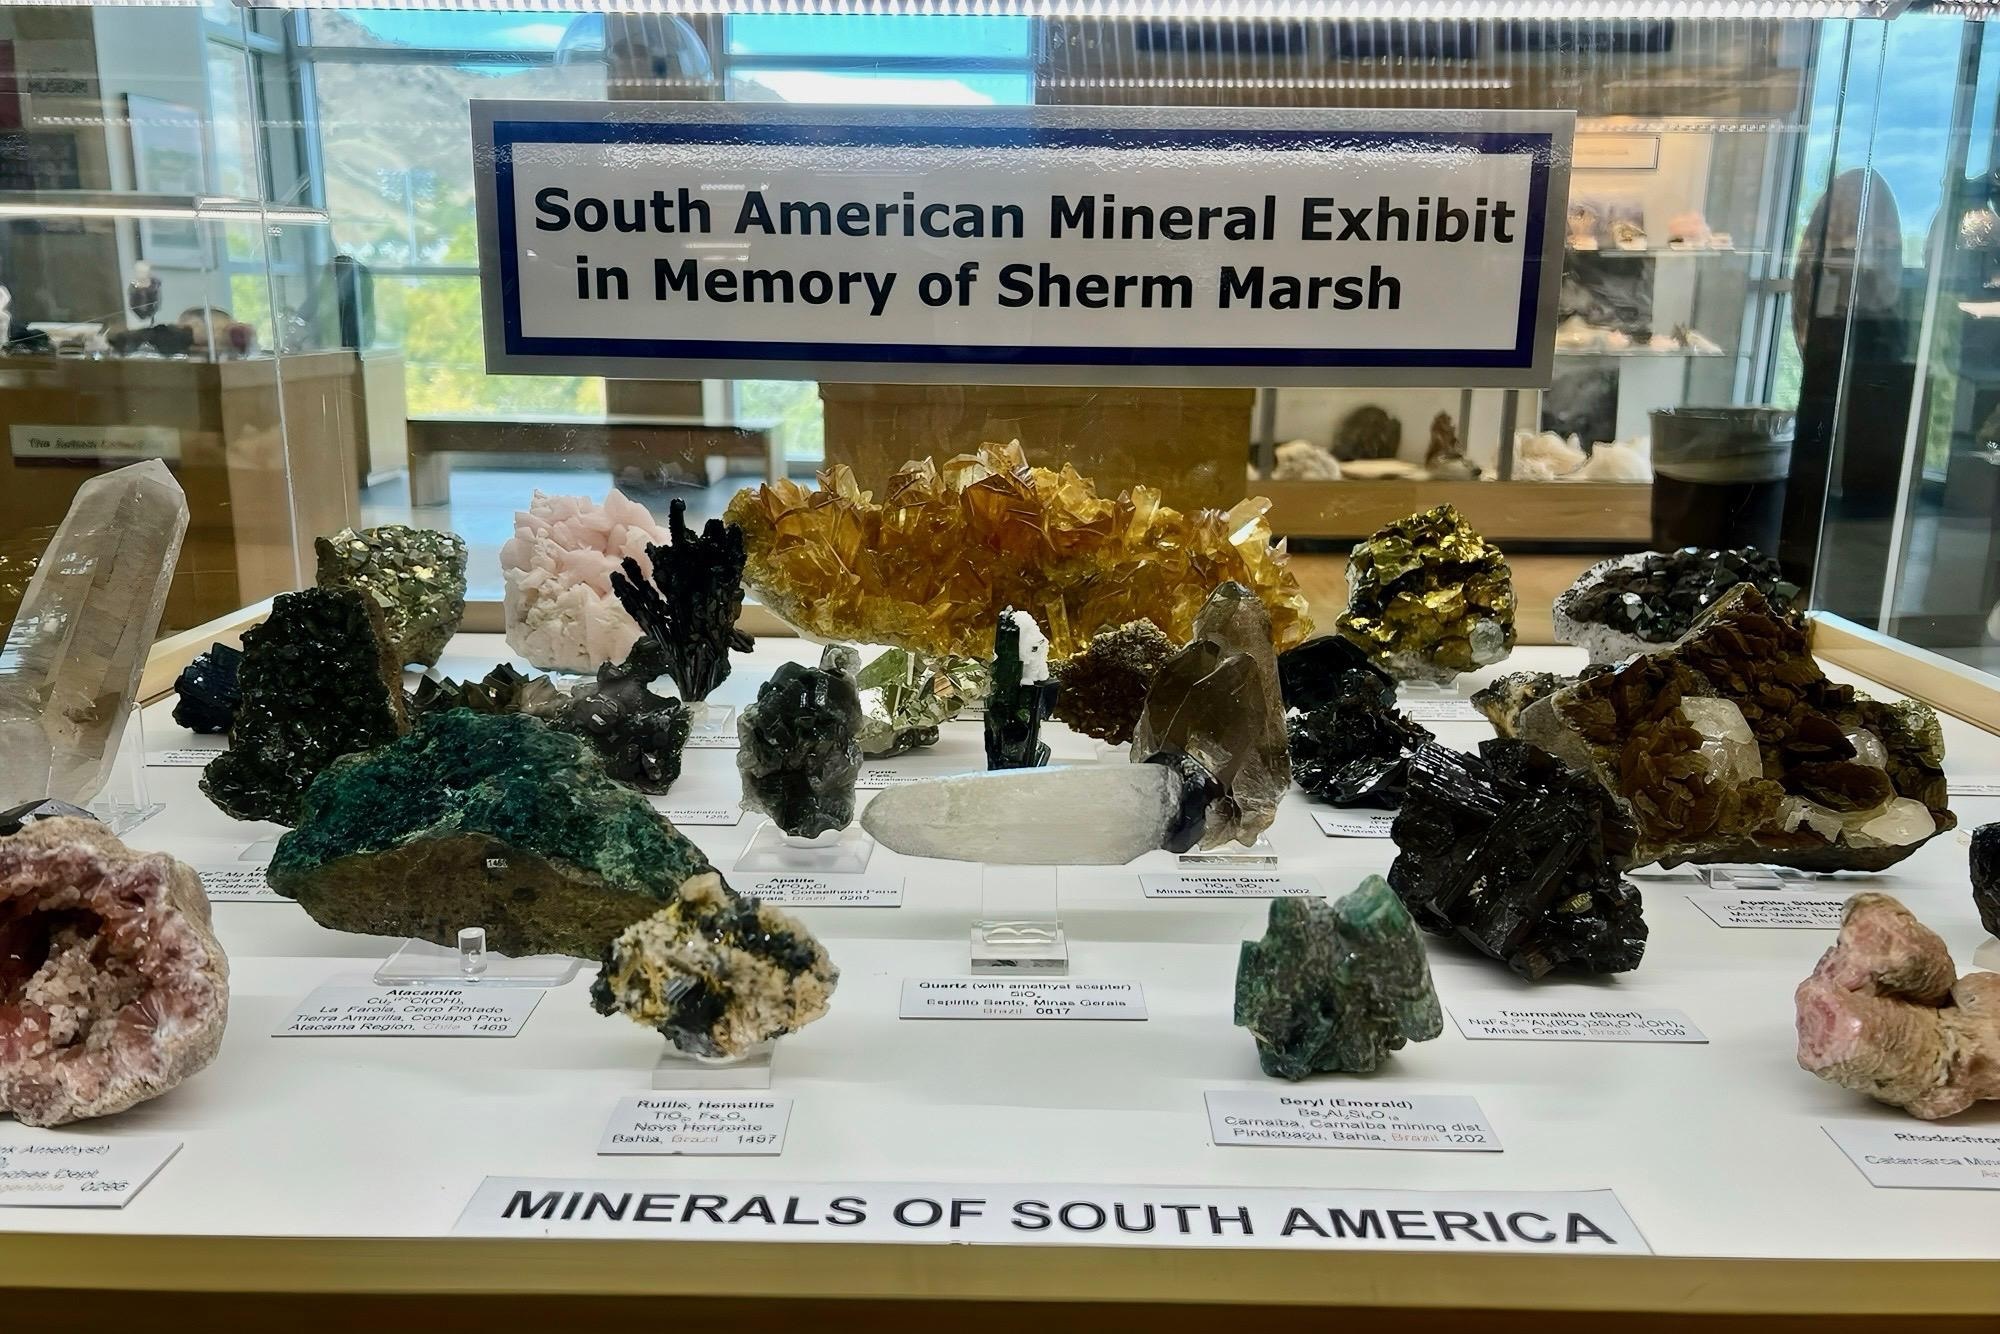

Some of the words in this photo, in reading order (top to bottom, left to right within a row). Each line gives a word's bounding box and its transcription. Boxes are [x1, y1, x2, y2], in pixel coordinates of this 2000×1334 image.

[534, 187, 711, 234] South
[734, 190, 1024, 239] American
[1050, 195, 1276, 241] Mineral
[1301, 196, 1516, 244] Exhibit
[576, 255, 629, 300] in
[654, 258, 897, 317] Memory
[918, 261, 979, 307] of
[998, 262, 1193, 309] Sherm
[1218, 264, 1401, 310] Marsh
[919, 981, 967, 990] Quartz
[972, 982, 1005, 990] (with
[1009, 983, 1071, 991] amethyst
[1080, 999, 1127, 1007] Gerais
[319, 1005, 339, 1013] La
[346, 1005, 397, 1014] Farola,
[402, 1004, 444, 1013] Cerro
[447, 1004, 504, 1014] Pintado
[983, 1007, 1023, 1015] Brazil
[1499, 1010, 1587, 1019] Tourmaline
[296, 1014, 339, 1022] Tierra
[340, 1014, 405, 1023] Amarilla,
[287, 1023, 356, 1032] Atacama
[359, 1023, 416, 1033] Region,
[422, 1023, 462, 1032] Chile
[1483, 1027, 1530, 1035] Minas
[1589, 1028, 1632, 1036] Brazil
[636, 1099, 692, 1110] Rutile,
[697, 1100, 776, 1110] Hematite
[1279, 1096, 1324, 1108] Beryl
[1329, 1097, 1414, 1110] (Emerald)
[633, 1121, 678, 1132] Novo
[682, 1122, 763, 1132] Horizonte
[1391, 1121, 1447, 1134] mining
[612, 1133, 664, 1145] Bahia,
[671, 1133, 719, 1144] Brazil
[1391, 1132, 1440, 1143] Brazil
[1447, 1133, 1488, 1145] 1202
[500, 1189, 869, 1229] MINERALS
[892, 1196, 988, 1230] OF
[1010, 1198, 1255, 1236] SOUTH
[1279, 1205, 1619, 1247] AMERICA
